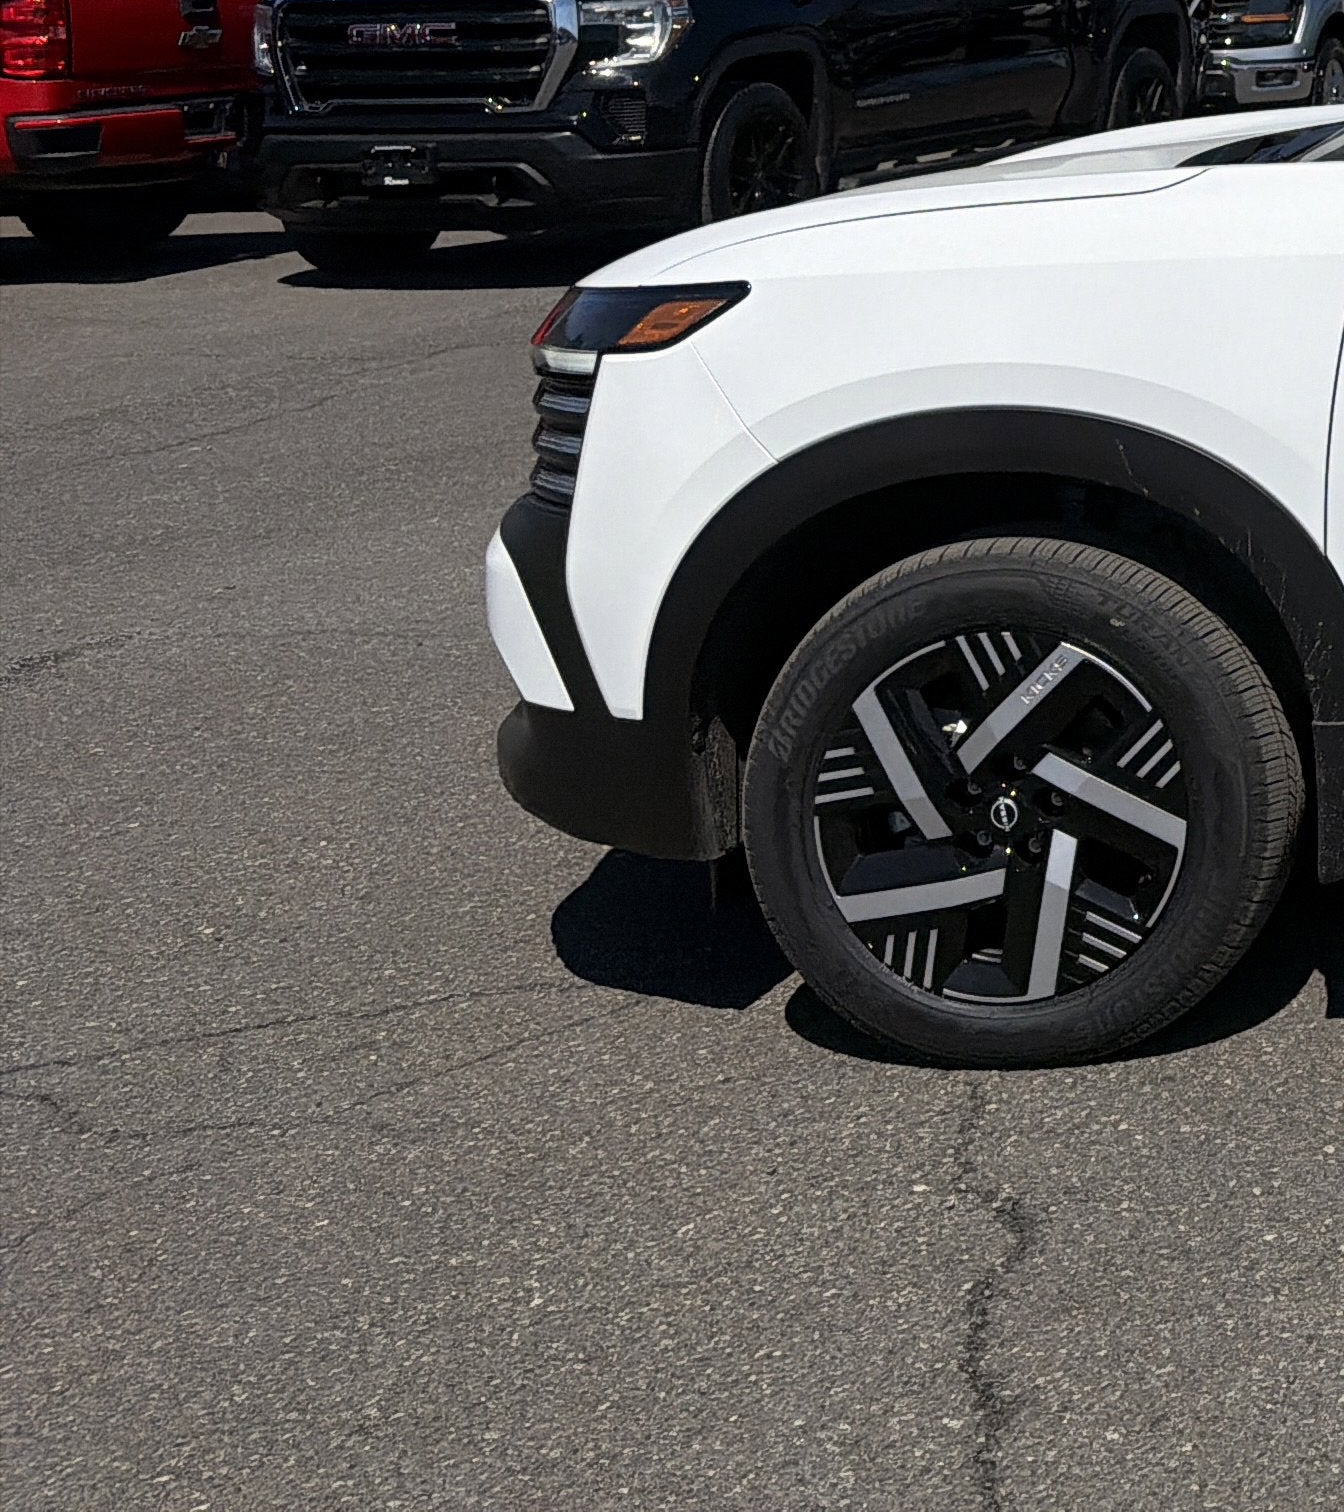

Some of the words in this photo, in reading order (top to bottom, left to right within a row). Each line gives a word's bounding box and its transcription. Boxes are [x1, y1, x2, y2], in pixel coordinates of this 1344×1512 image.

[347, 22, 460, 46] GMC
[766, 597, 929, 764] BRIDGESTONE
[1020, 653, 1069, 705] KICKS
